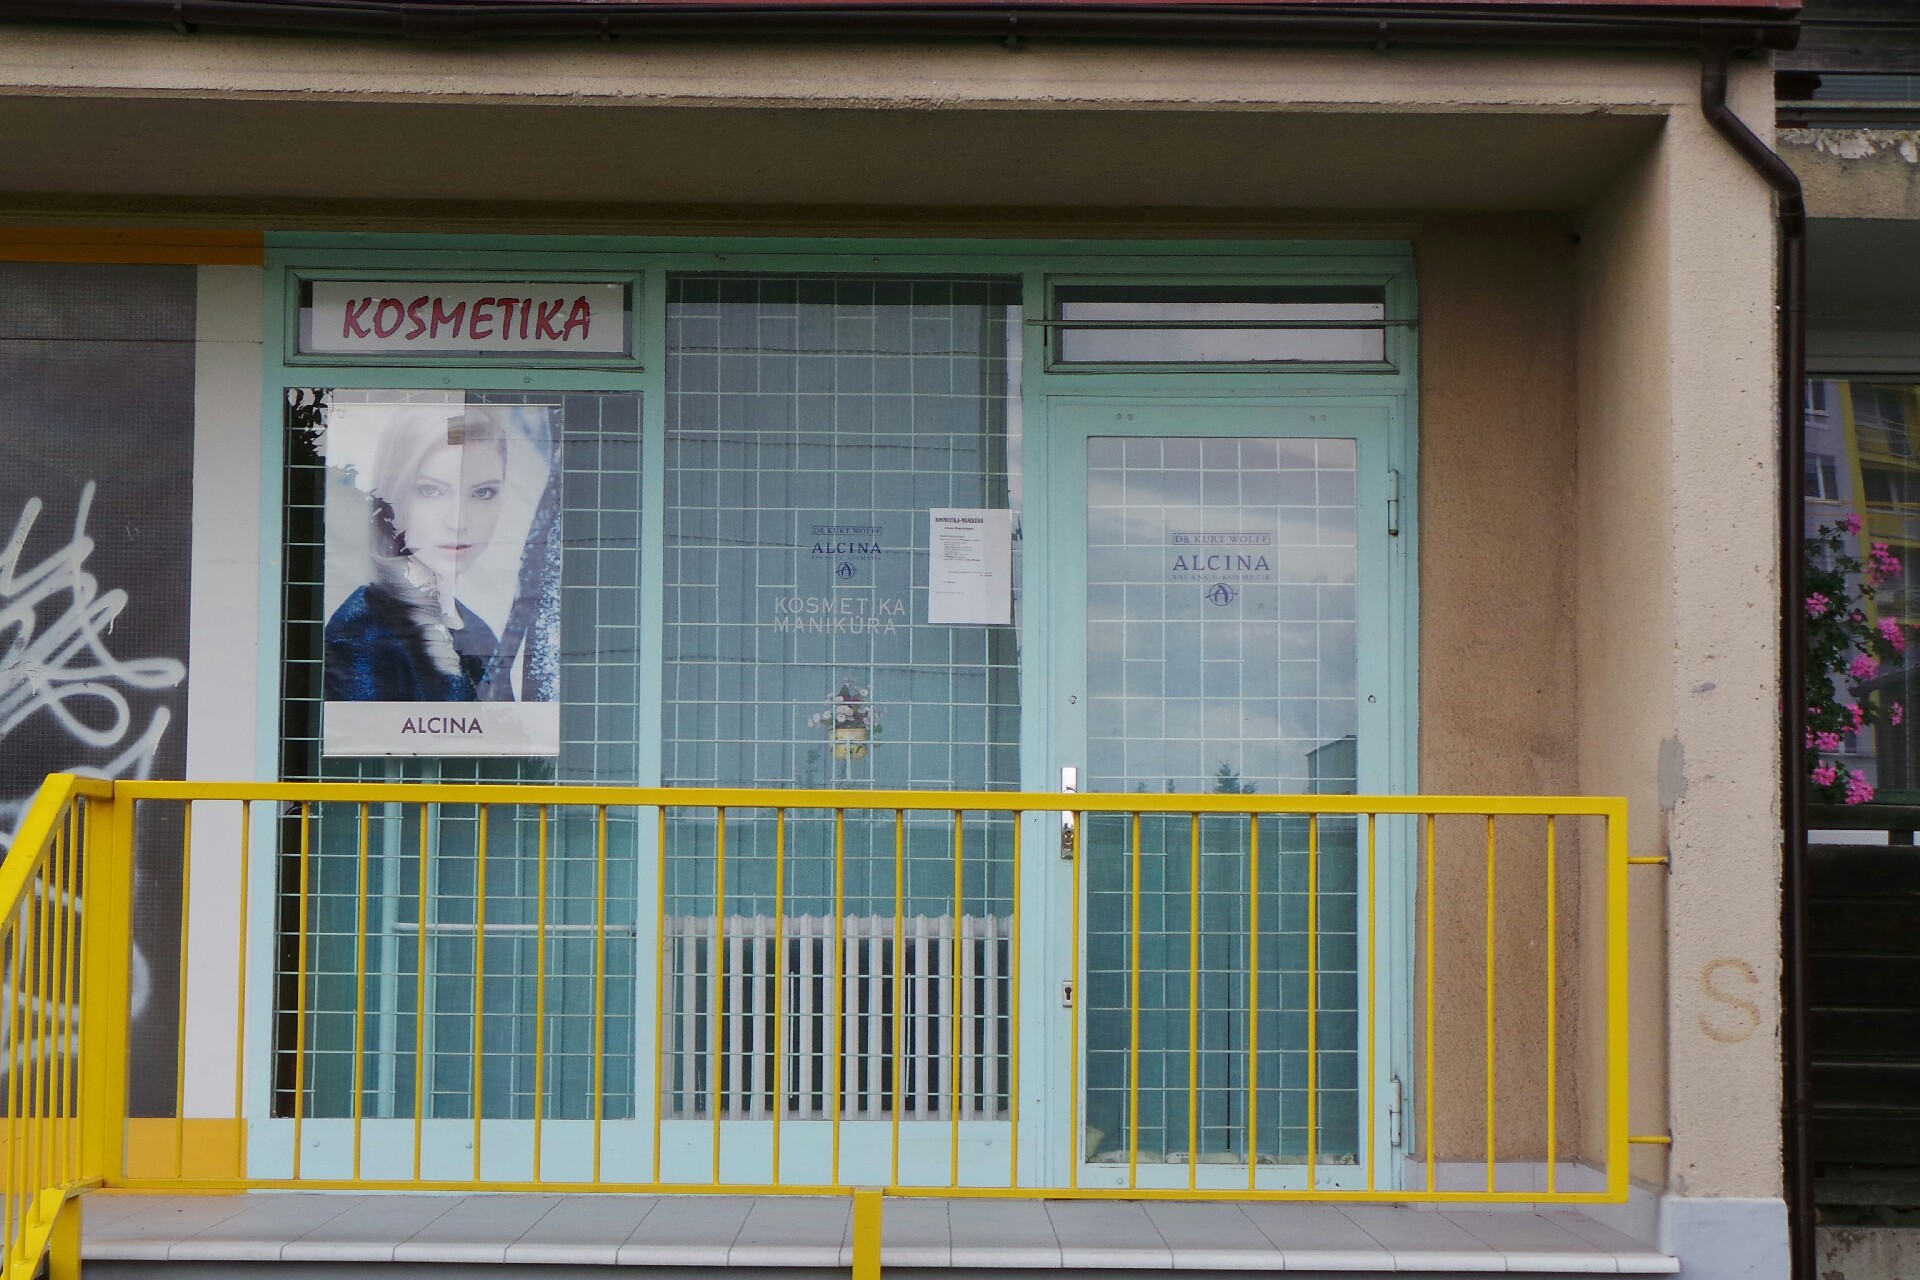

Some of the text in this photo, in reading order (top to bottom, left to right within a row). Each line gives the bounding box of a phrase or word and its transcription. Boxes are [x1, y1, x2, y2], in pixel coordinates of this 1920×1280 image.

[343, 295, 591, 341] KOSMETIKA
[1194, 535, 1226, 543] KURT
[1229, 535, 1267, 543] WOLFF
[811, 542, 882, 554] ALCINA
[1172, 554, 1270, 571] ALCINA
[774, 615, 897, 634] MANIKÚRA
[401, 717, 483, 734] ALCINA
